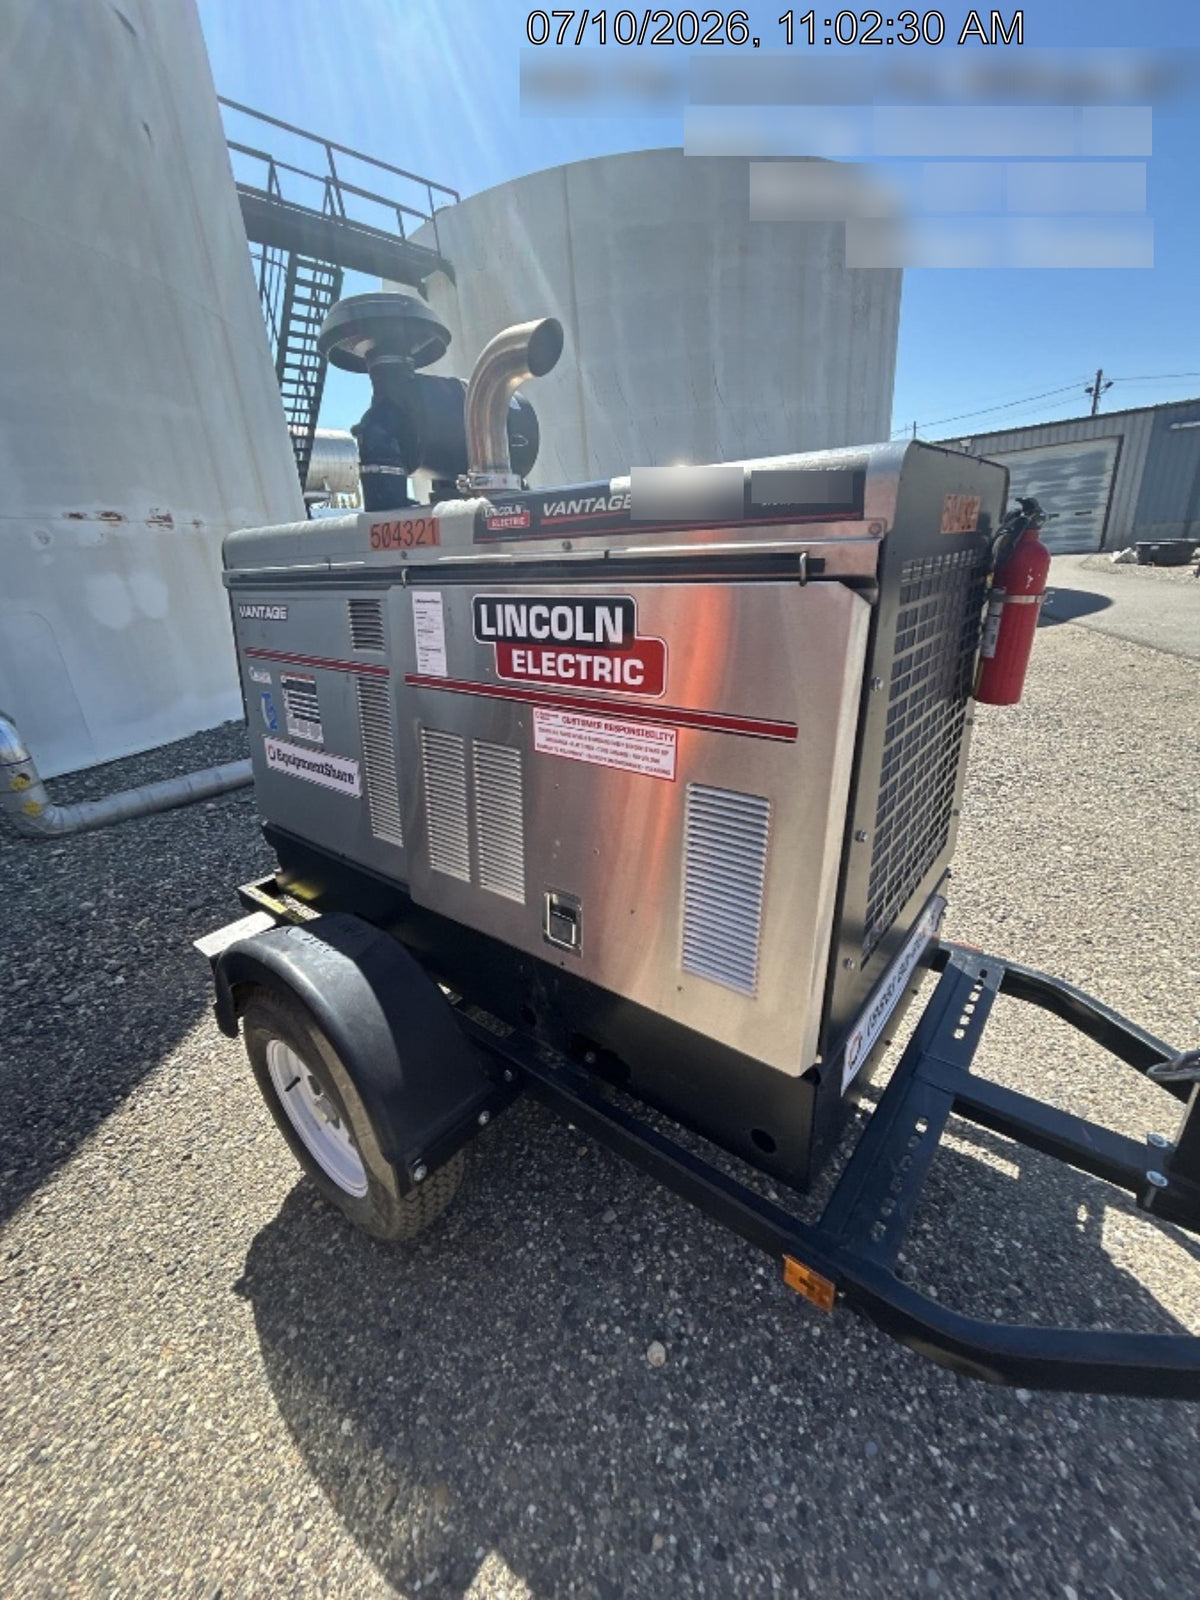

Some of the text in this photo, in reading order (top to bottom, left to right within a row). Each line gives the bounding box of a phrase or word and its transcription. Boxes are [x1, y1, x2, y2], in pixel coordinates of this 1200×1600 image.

[543, 494, 632, 516] VANTAGE
[370, 517, 438, 549] 504321
[239, 605, 287, 620] VANTAGE
[480, 603, 624, 645] LINCOLN
[511, 648, 645, 686] ELECTRIC
[276, 747, 355, 785] EquipmentShare
